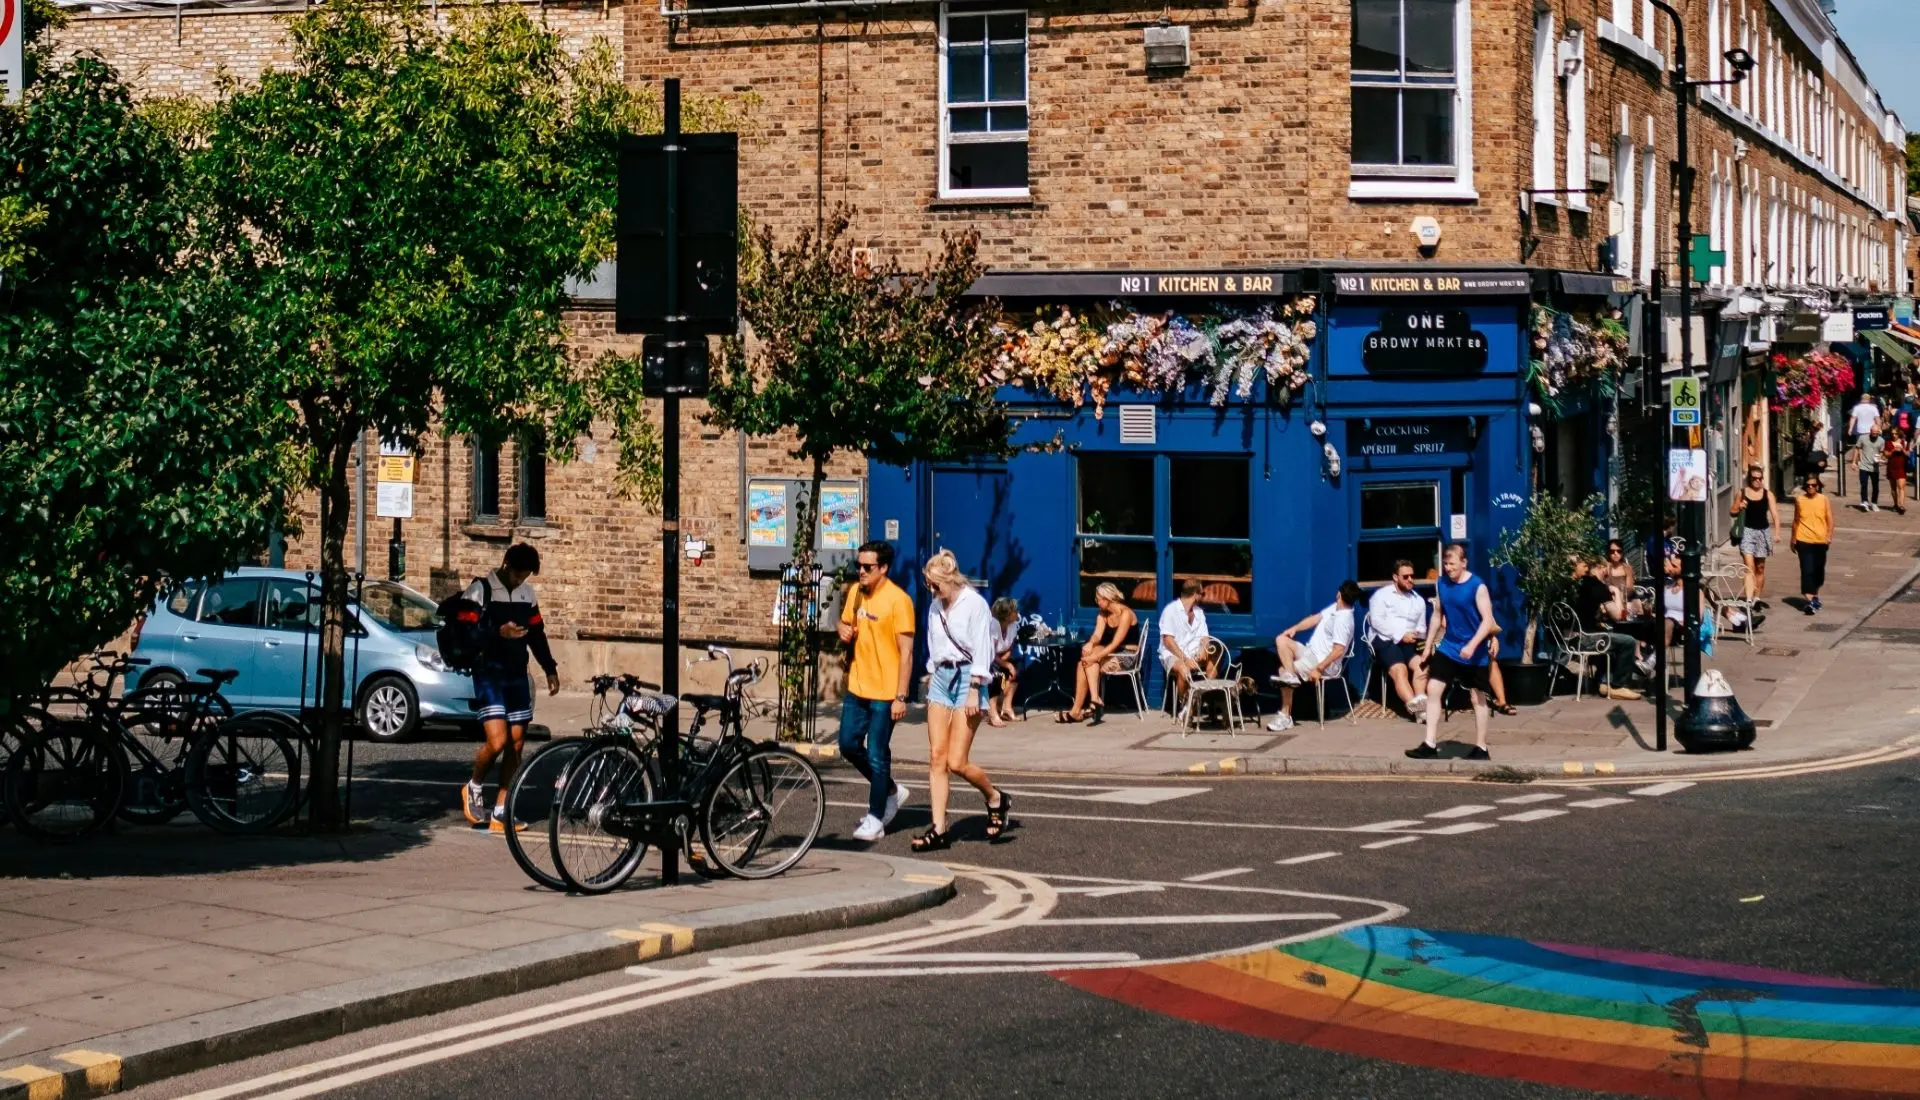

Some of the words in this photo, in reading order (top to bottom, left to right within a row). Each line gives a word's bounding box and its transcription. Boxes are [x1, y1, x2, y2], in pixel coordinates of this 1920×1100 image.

[1158, 277, 1219, 292] KITCHEN
[1224, 277, 1236, 292] &
[1242, 277, 1273, 292] BAR
[1370, 278, 1419, 292] KITCHEN
[1423, 279, 1434, 291] &
[1438, 278, 1460, 291] BAR
[1408, 315, 1445, 329] ONE
[1370, 337, 1419, 349] BRDWY
[1426, 337, 1462, 348] MRKT
[1375, 425, 1430, 436] COCKTAILS
[1413, 443, 1446, 453] SPRITZ
